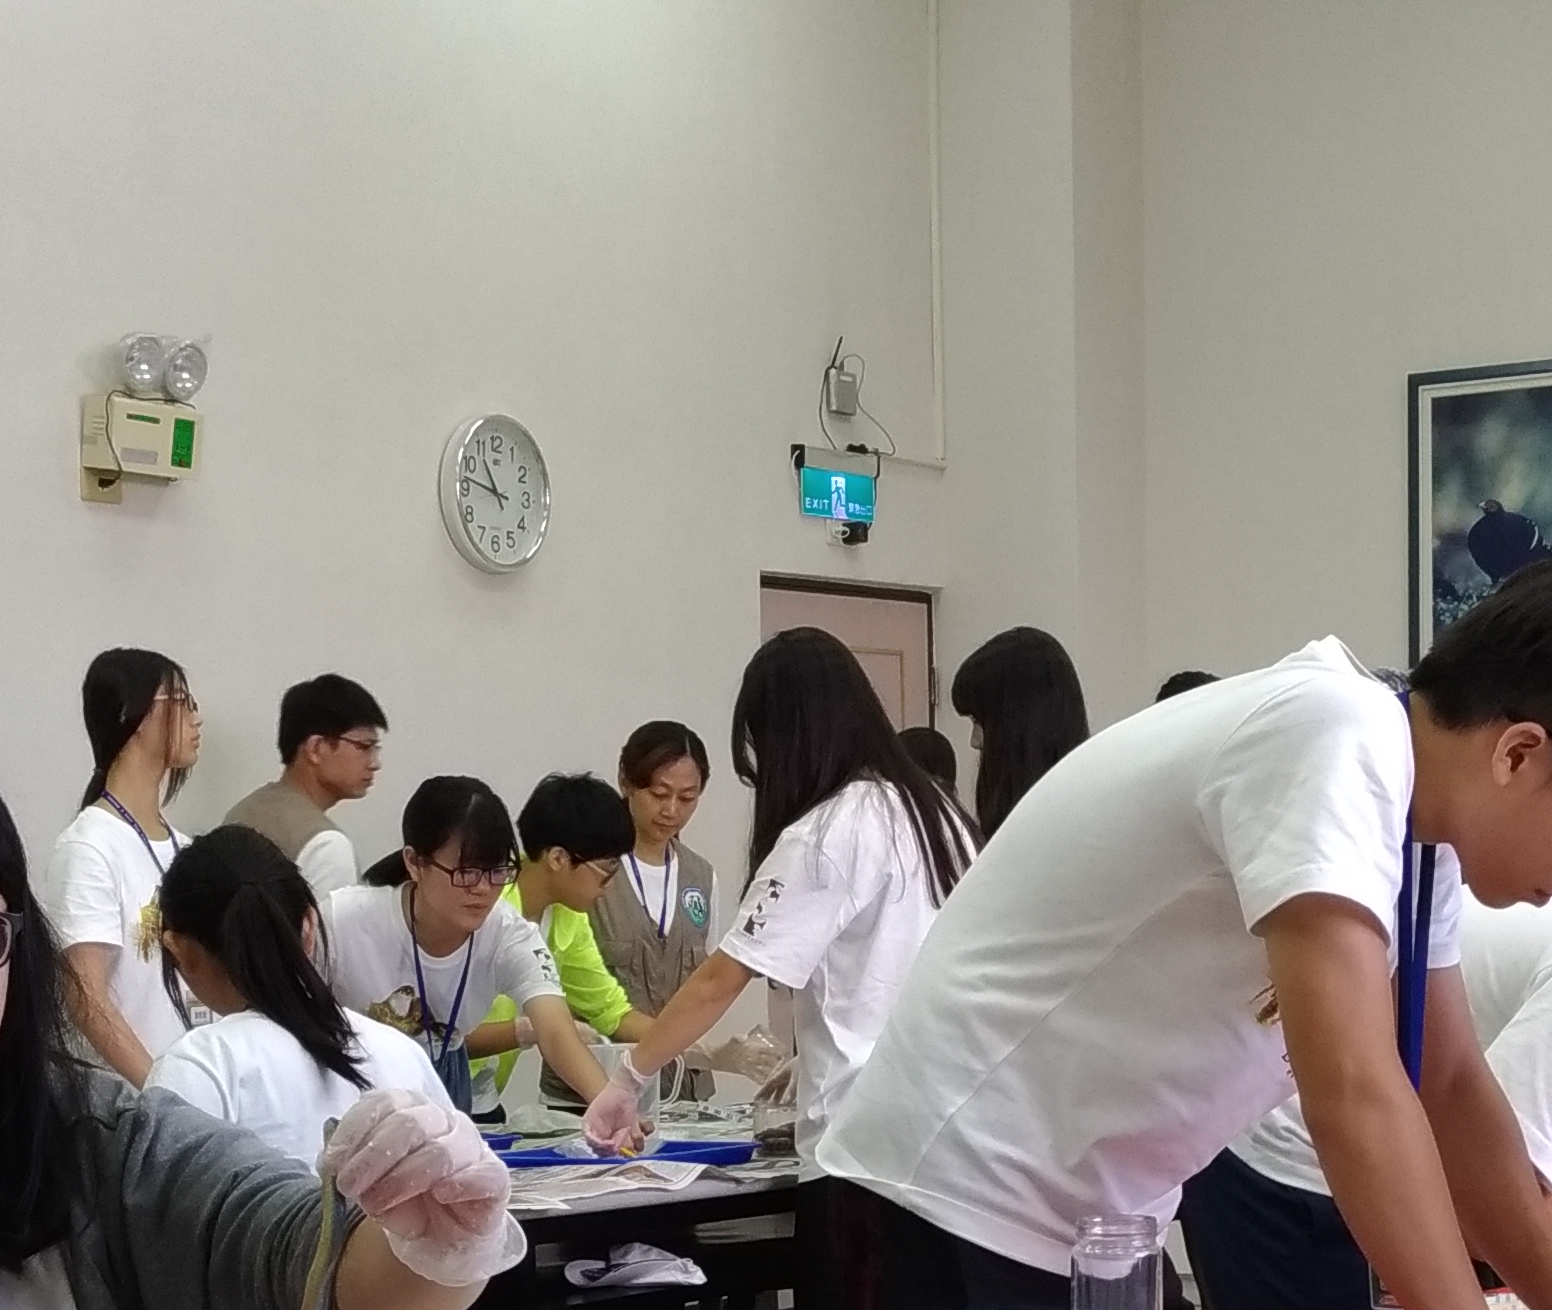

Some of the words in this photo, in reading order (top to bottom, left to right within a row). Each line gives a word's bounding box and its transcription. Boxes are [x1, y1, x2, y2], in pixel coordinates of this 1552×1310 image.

[476, 440, 485, 457] 11
[490, 435, 502, 454] 12
[509, 446, 515, 463] 1
[464, 455, 476, 473] 10
[518, 466, 528, 484] 2
[461, 479, 470, 497] 9
[521, 491, 531, 509] 3
[805, 497, 829, 510] EXIT
[464, 505, 474, 523] 8
[517, 516, 526, 533] 4
[477, 525, 486, 544] 7
[506, 530, 515, 549] 5
[491, 535, 500, 553] 6
